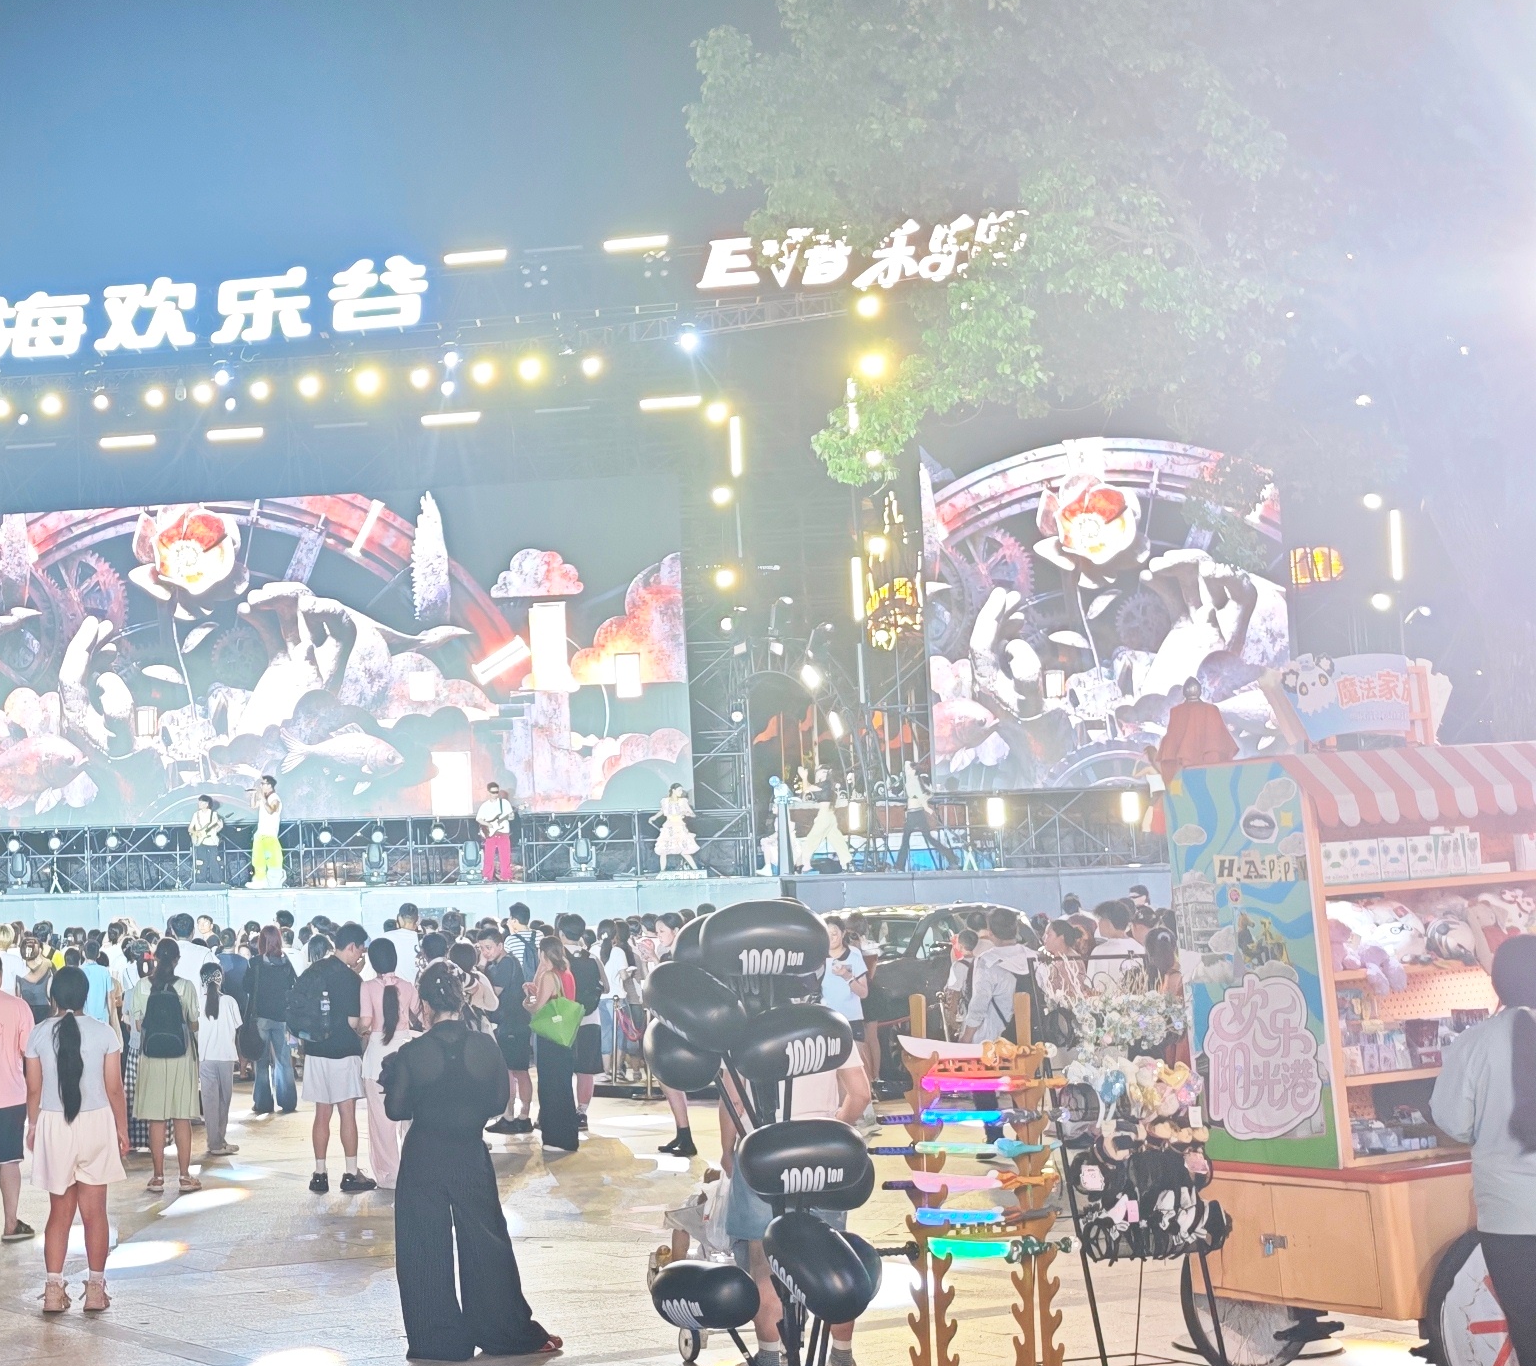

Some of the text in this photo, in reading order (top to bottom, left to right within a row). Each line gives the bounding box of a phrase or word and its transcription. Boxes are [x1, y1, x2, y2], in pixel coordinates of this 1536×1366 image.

[739, 948, 804, 975] 1000 ton
[785, 1035, 841, 1076] 1000 ton
[780, 1166, 844, 1194] 1000 ton
[661, 1297, 704, 1328] 1000
